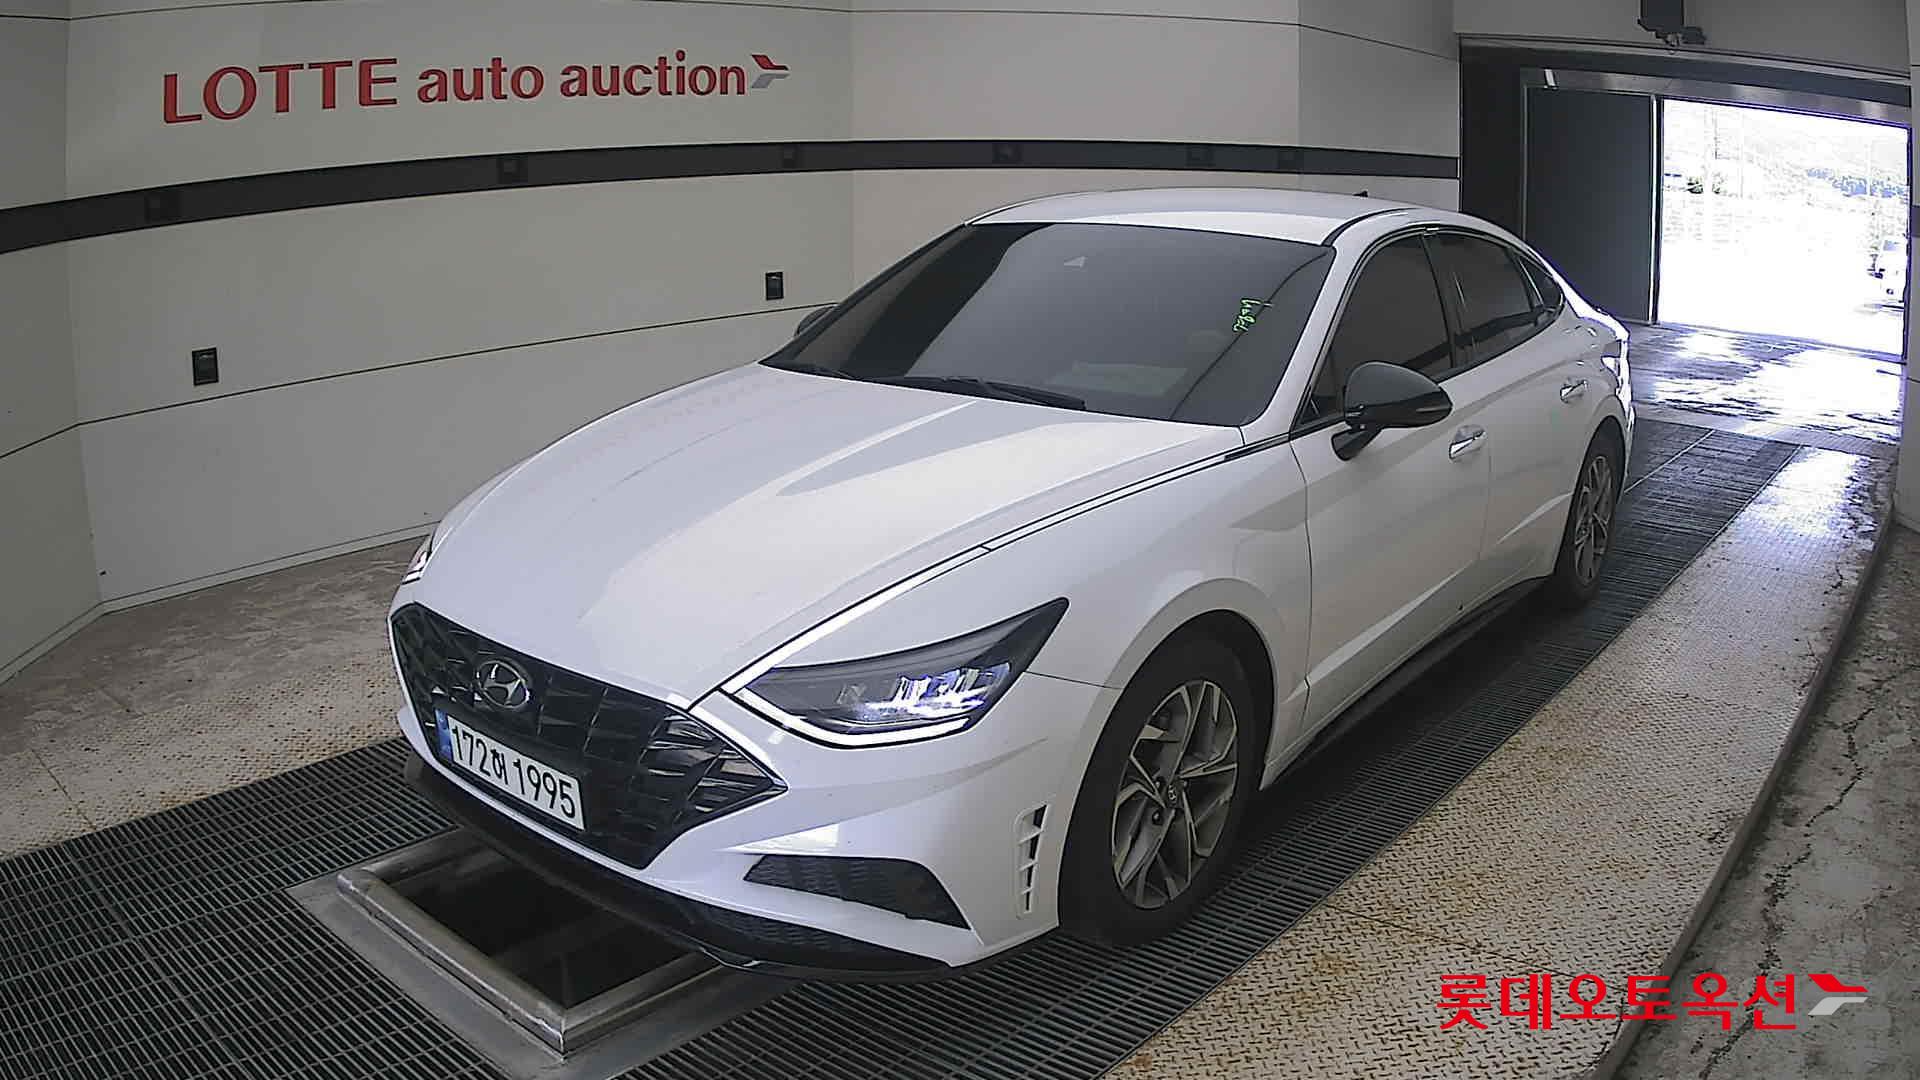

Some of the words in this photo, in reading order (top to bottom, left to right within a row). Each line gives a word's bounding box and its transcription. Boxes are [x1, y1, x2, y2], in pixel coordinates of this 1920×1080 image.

[163, 57, 398, 124] LOTTE
[417, 56, 545, 103] auto
[560, 49, 746, 97] auction
[513, 758, 576, 818] 1995
